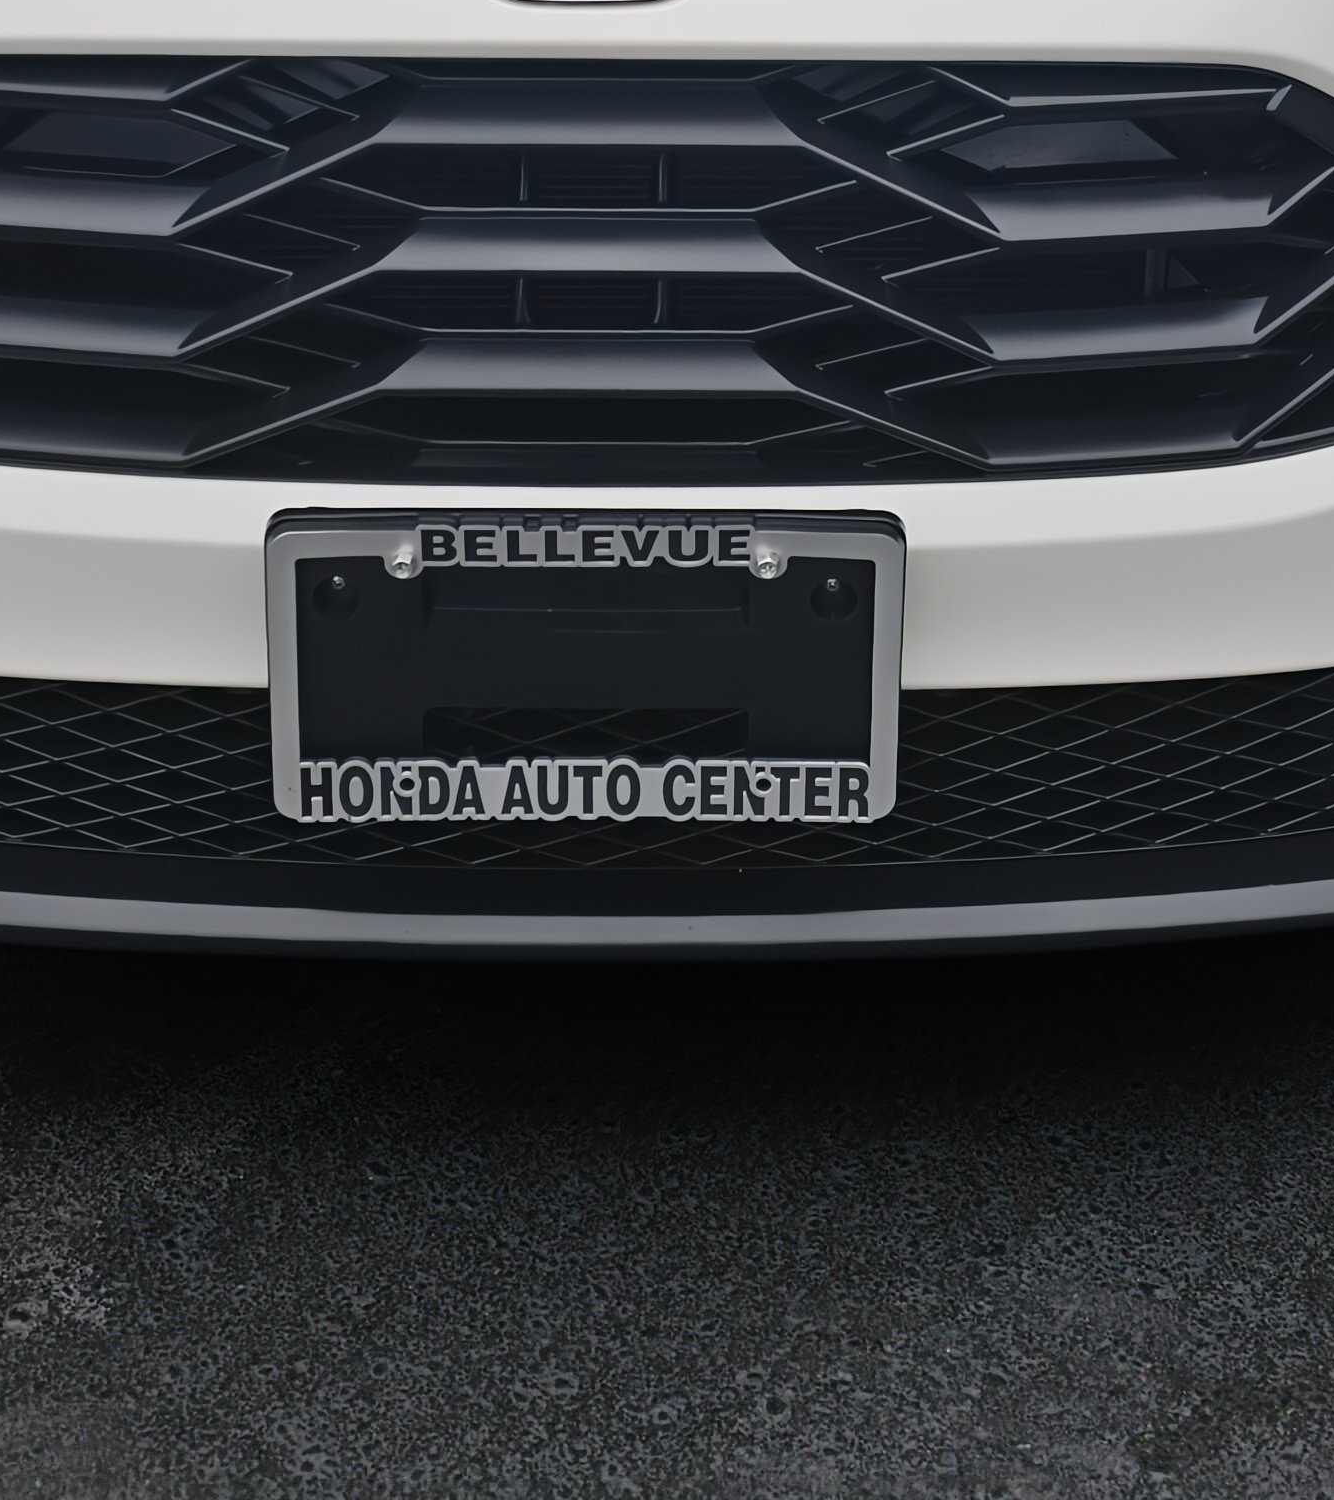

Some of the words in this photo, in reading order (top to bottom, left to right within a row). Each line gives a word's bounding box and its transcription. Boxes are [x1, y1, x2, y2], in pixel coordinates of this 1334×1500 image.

[419, 528, 752, 563] BELLEVUE
[299, 764, 486, 818] HONDA
[500, 763, 642, 817] AUTO
[662, 763, 871, 818] CENTER
